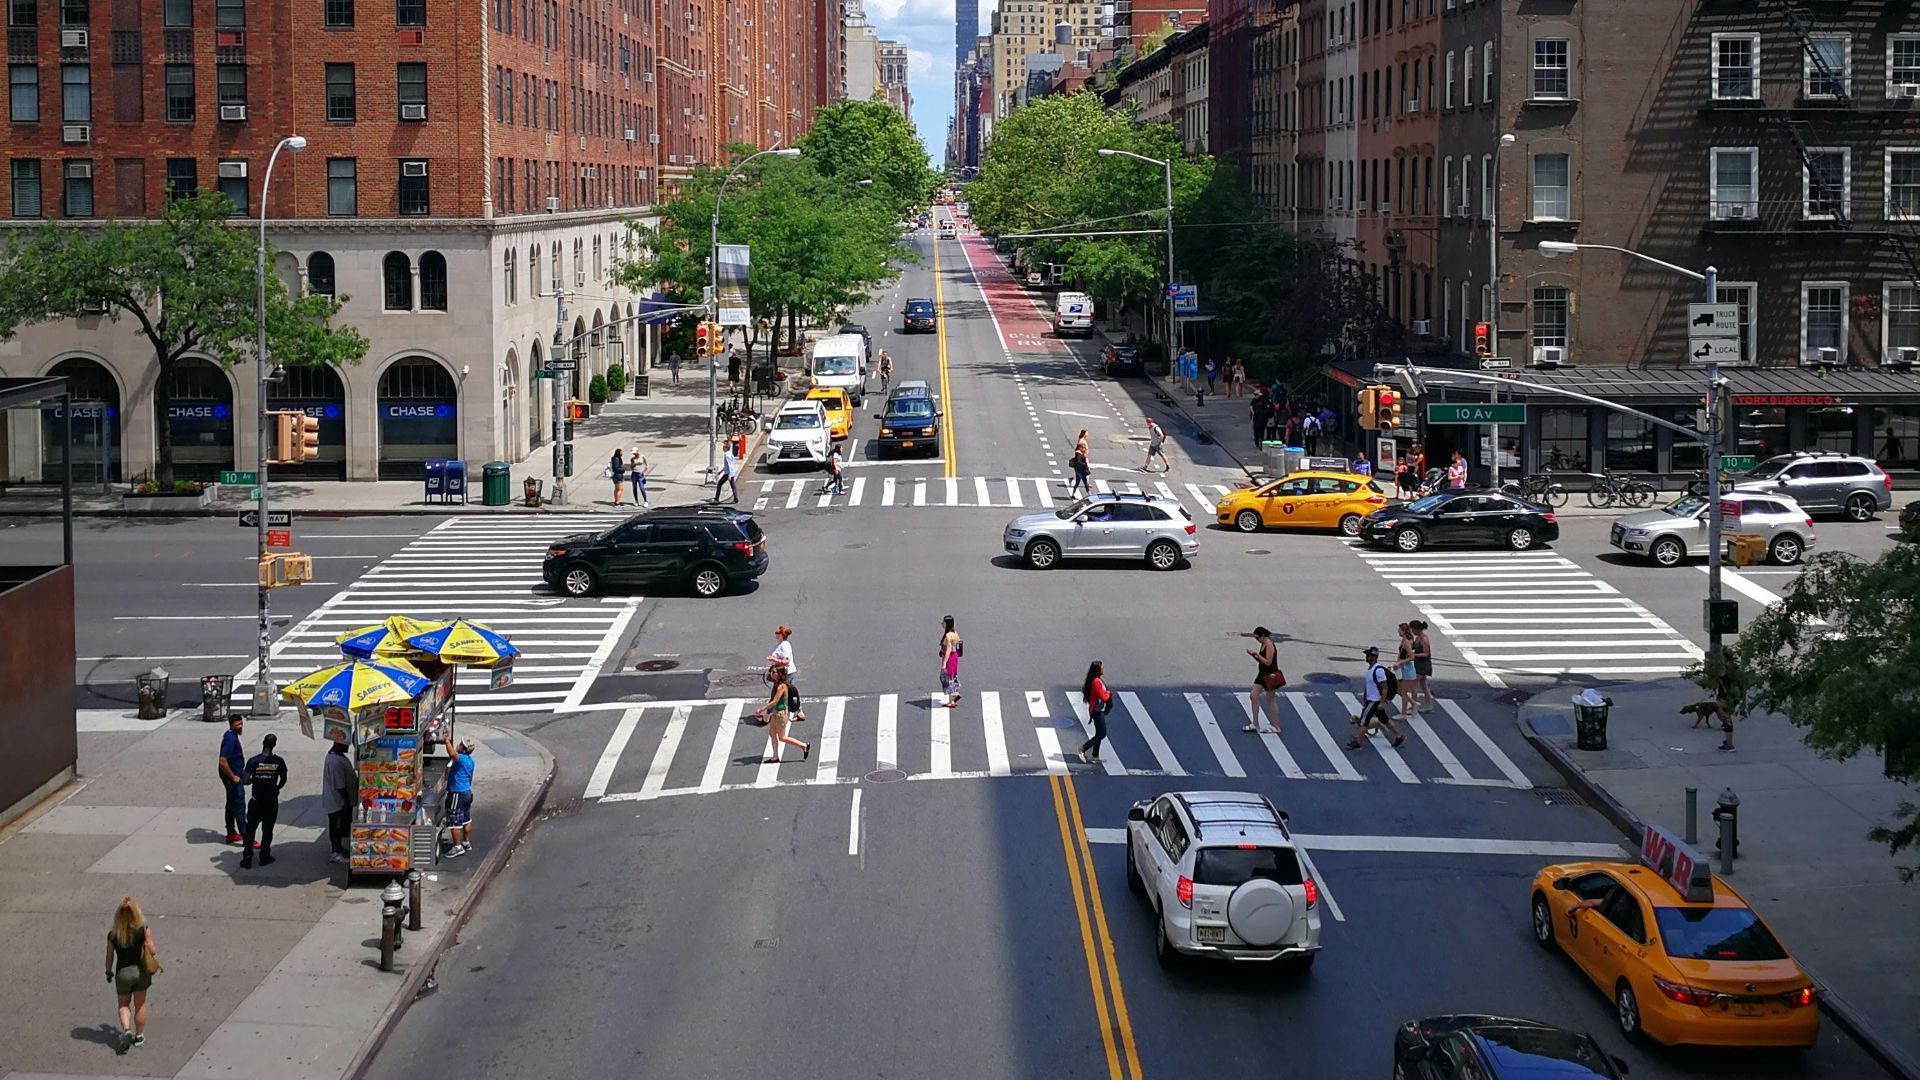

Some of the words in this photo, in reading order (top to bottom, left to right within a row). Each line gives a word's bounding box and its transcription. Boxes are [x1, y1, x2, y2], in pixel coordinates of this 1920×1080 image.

[1715, 310, 1736, 318] TRUCK
[1715, 321, 1736, 329] ROUTE
[1714, 346, 1738, 354] LOCAL
[1739, 396, 1767, 404] YORK
[1769, 396, 1814, 404] BURGER
[55, 408, 100, 418] CASE
[390, 406, 435, 417] CHASE
[1456, 408, 1470, 419] 10
[1474, 408, 1493, 419] Av
[1726, 457, 1738, 467] 10
[225, 473, 238, 484] 10
